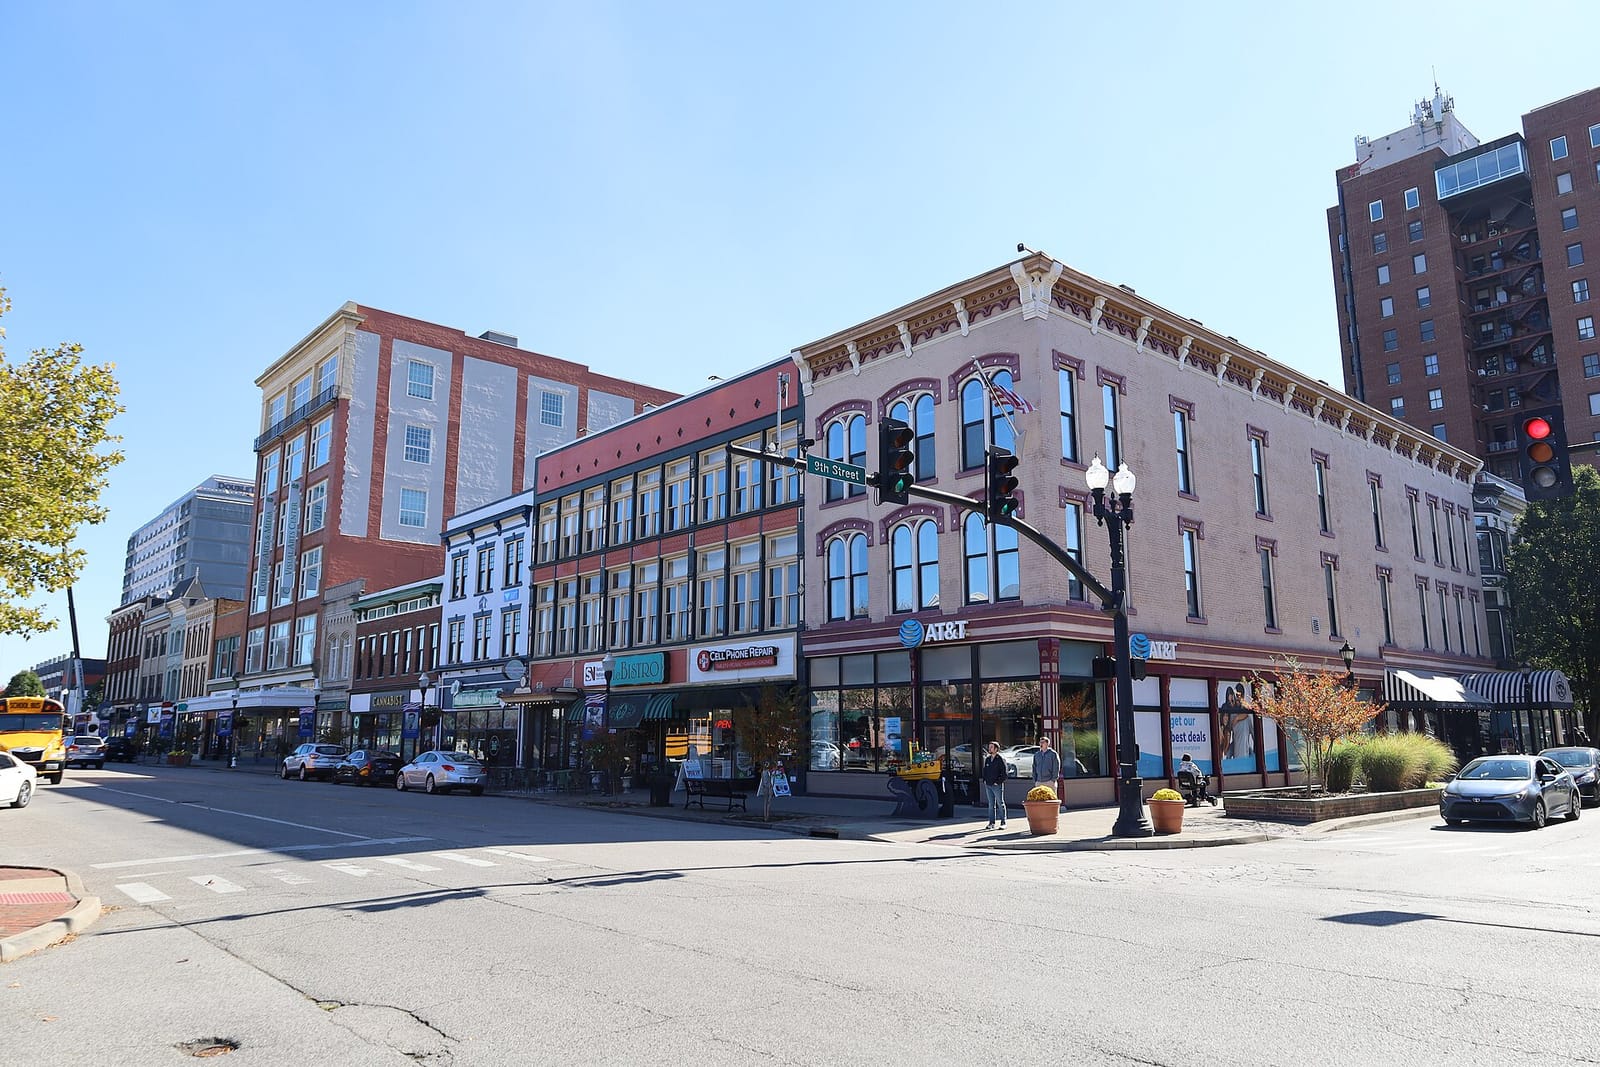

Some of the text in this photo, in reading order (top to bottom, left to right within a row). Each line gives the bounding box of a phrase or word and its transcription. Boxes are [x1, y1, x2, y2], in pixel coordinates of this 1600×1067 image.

[814, 461, 860, 481] 9th Street
[285, 502, 298, 576] VISUAL ARTS CENTER
[925, 620, 969, 642] AT&T
[709, 646, 774, 662] CELL PHONE REPAIR
[1149, 641, 1178, 660] AT&T
[1170, 716, 1196, 729] get our
[1170, 730, 1207, 743] best deals
